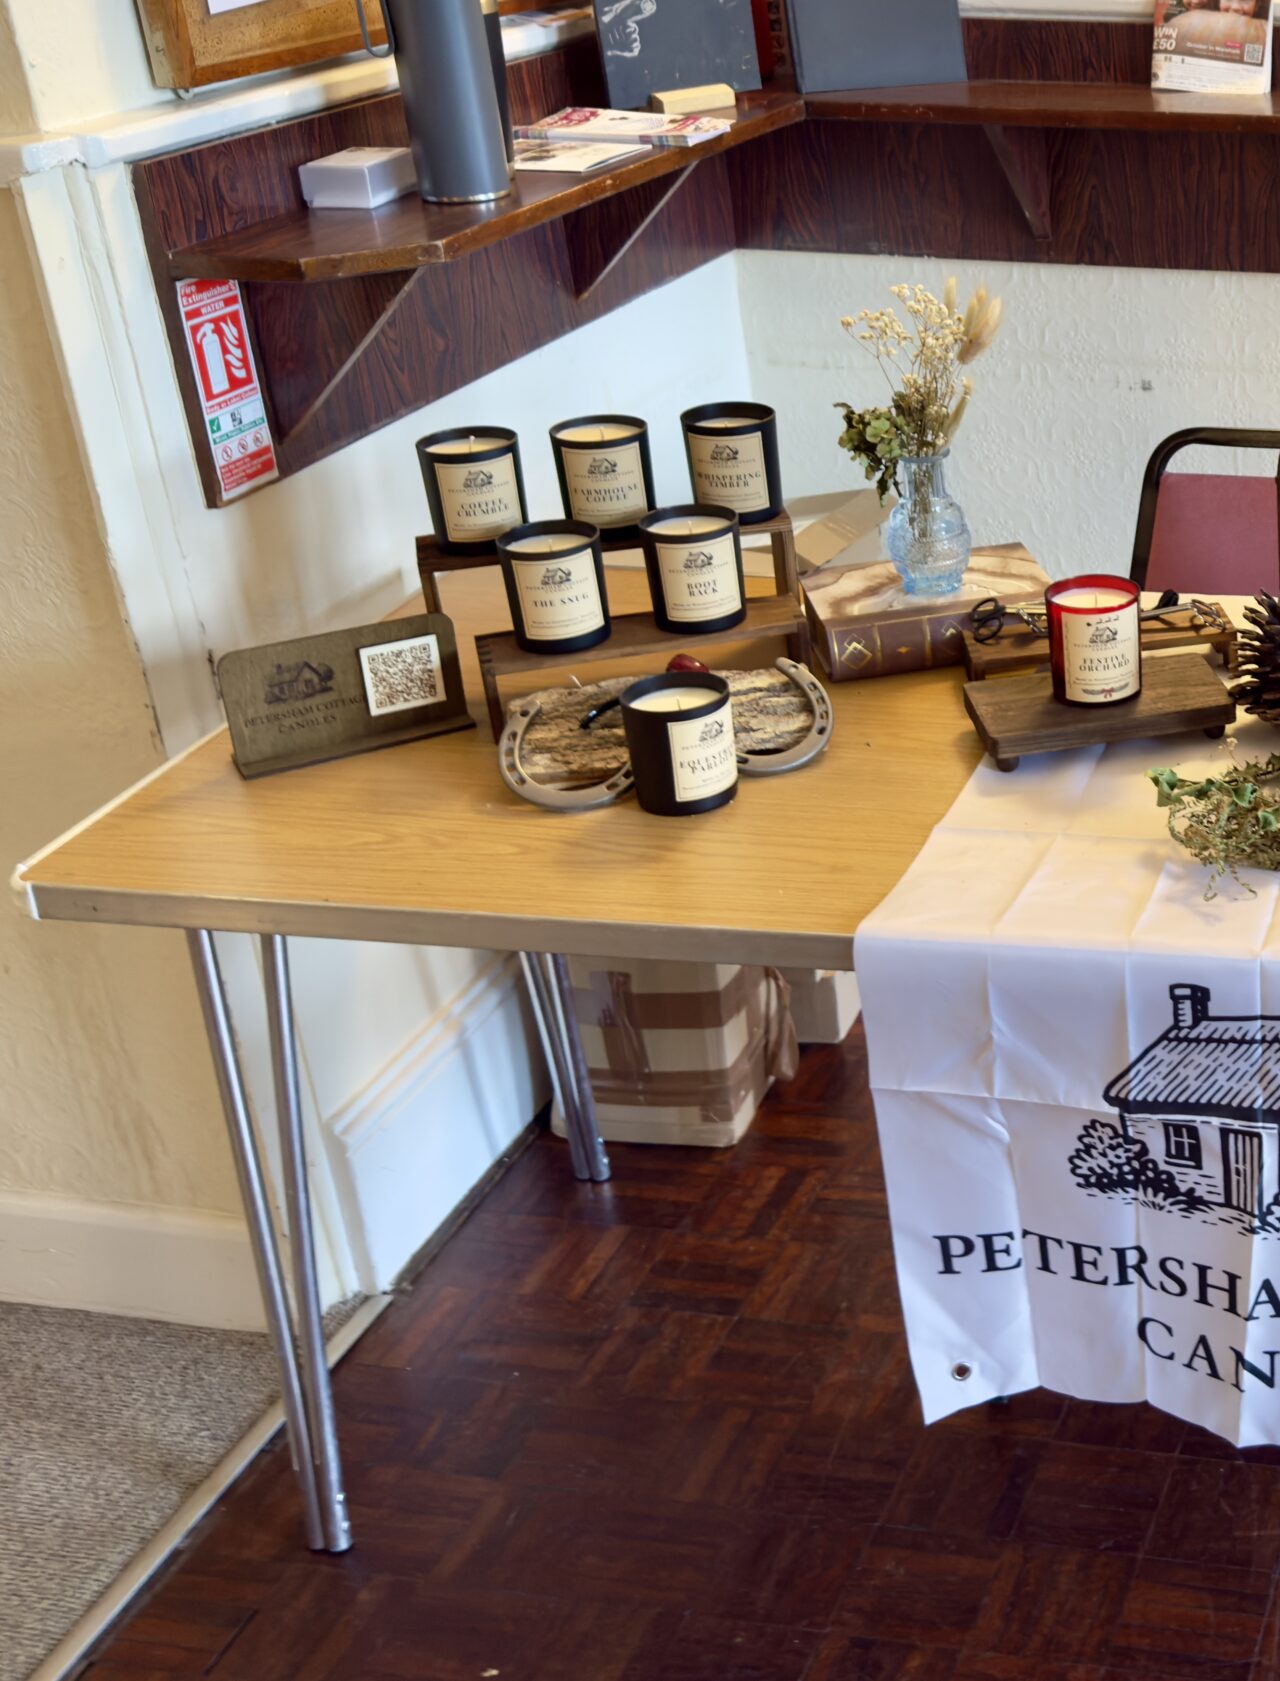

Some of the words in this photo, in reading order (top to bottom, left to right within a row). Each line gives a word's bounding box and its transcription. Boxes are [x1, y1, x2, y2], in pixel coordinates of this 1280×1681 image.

[1154, 26, 1178, 39] WIN
[1153, 39, 1176, 51] £50
[180, 284, 196, 296] Fire
[200, 300, 224, 315] WATER
[697, 471, 761, 482] WHISPERING
[573, 482, 637, 497] FARMHOUSE
[709, 480, 750, 489] TIMBER
[460, 497, 503, 511] COFFEE
[585, 493, 626, 503] COFFEE
[457, 503, 509, 518] CRUMBLE
[687, 579, 718, 590] BOOT
[689, 587, 718, 598] RACK
[533, 599, 554, 609] THE
[560, 590, 590, 605] SNUG
[1078, 659, 1130, 672] ORCHARD
[1083, 653, 1128, 665] FESTIVE
[243, 704, 315, 728] PETERSHAM
[277, 714, 338, 734] CANDLES
